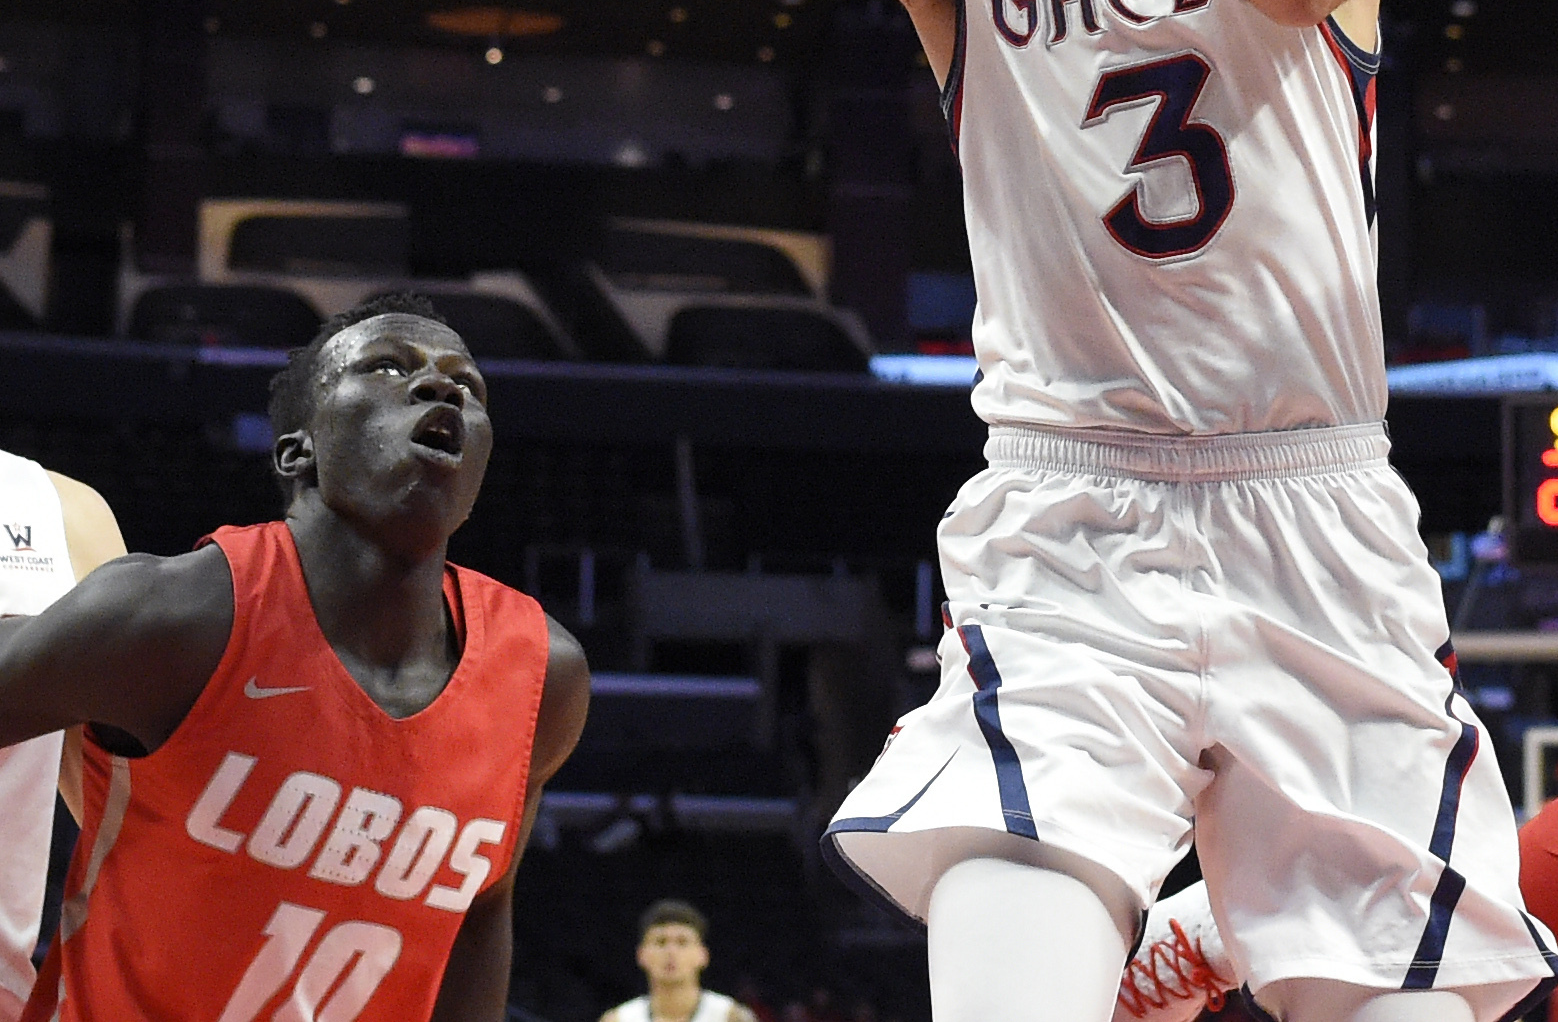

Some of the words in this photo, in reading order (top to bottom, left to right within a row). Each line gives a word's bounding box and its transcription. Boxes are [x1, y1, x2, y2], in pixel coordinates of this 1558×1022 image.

[1080, 49, 1236, 266] 3
[27, 556, 54, 566] COAST
[185, 750, 507, 914] LOBOS
[217, 900, 404, 1022] 10
